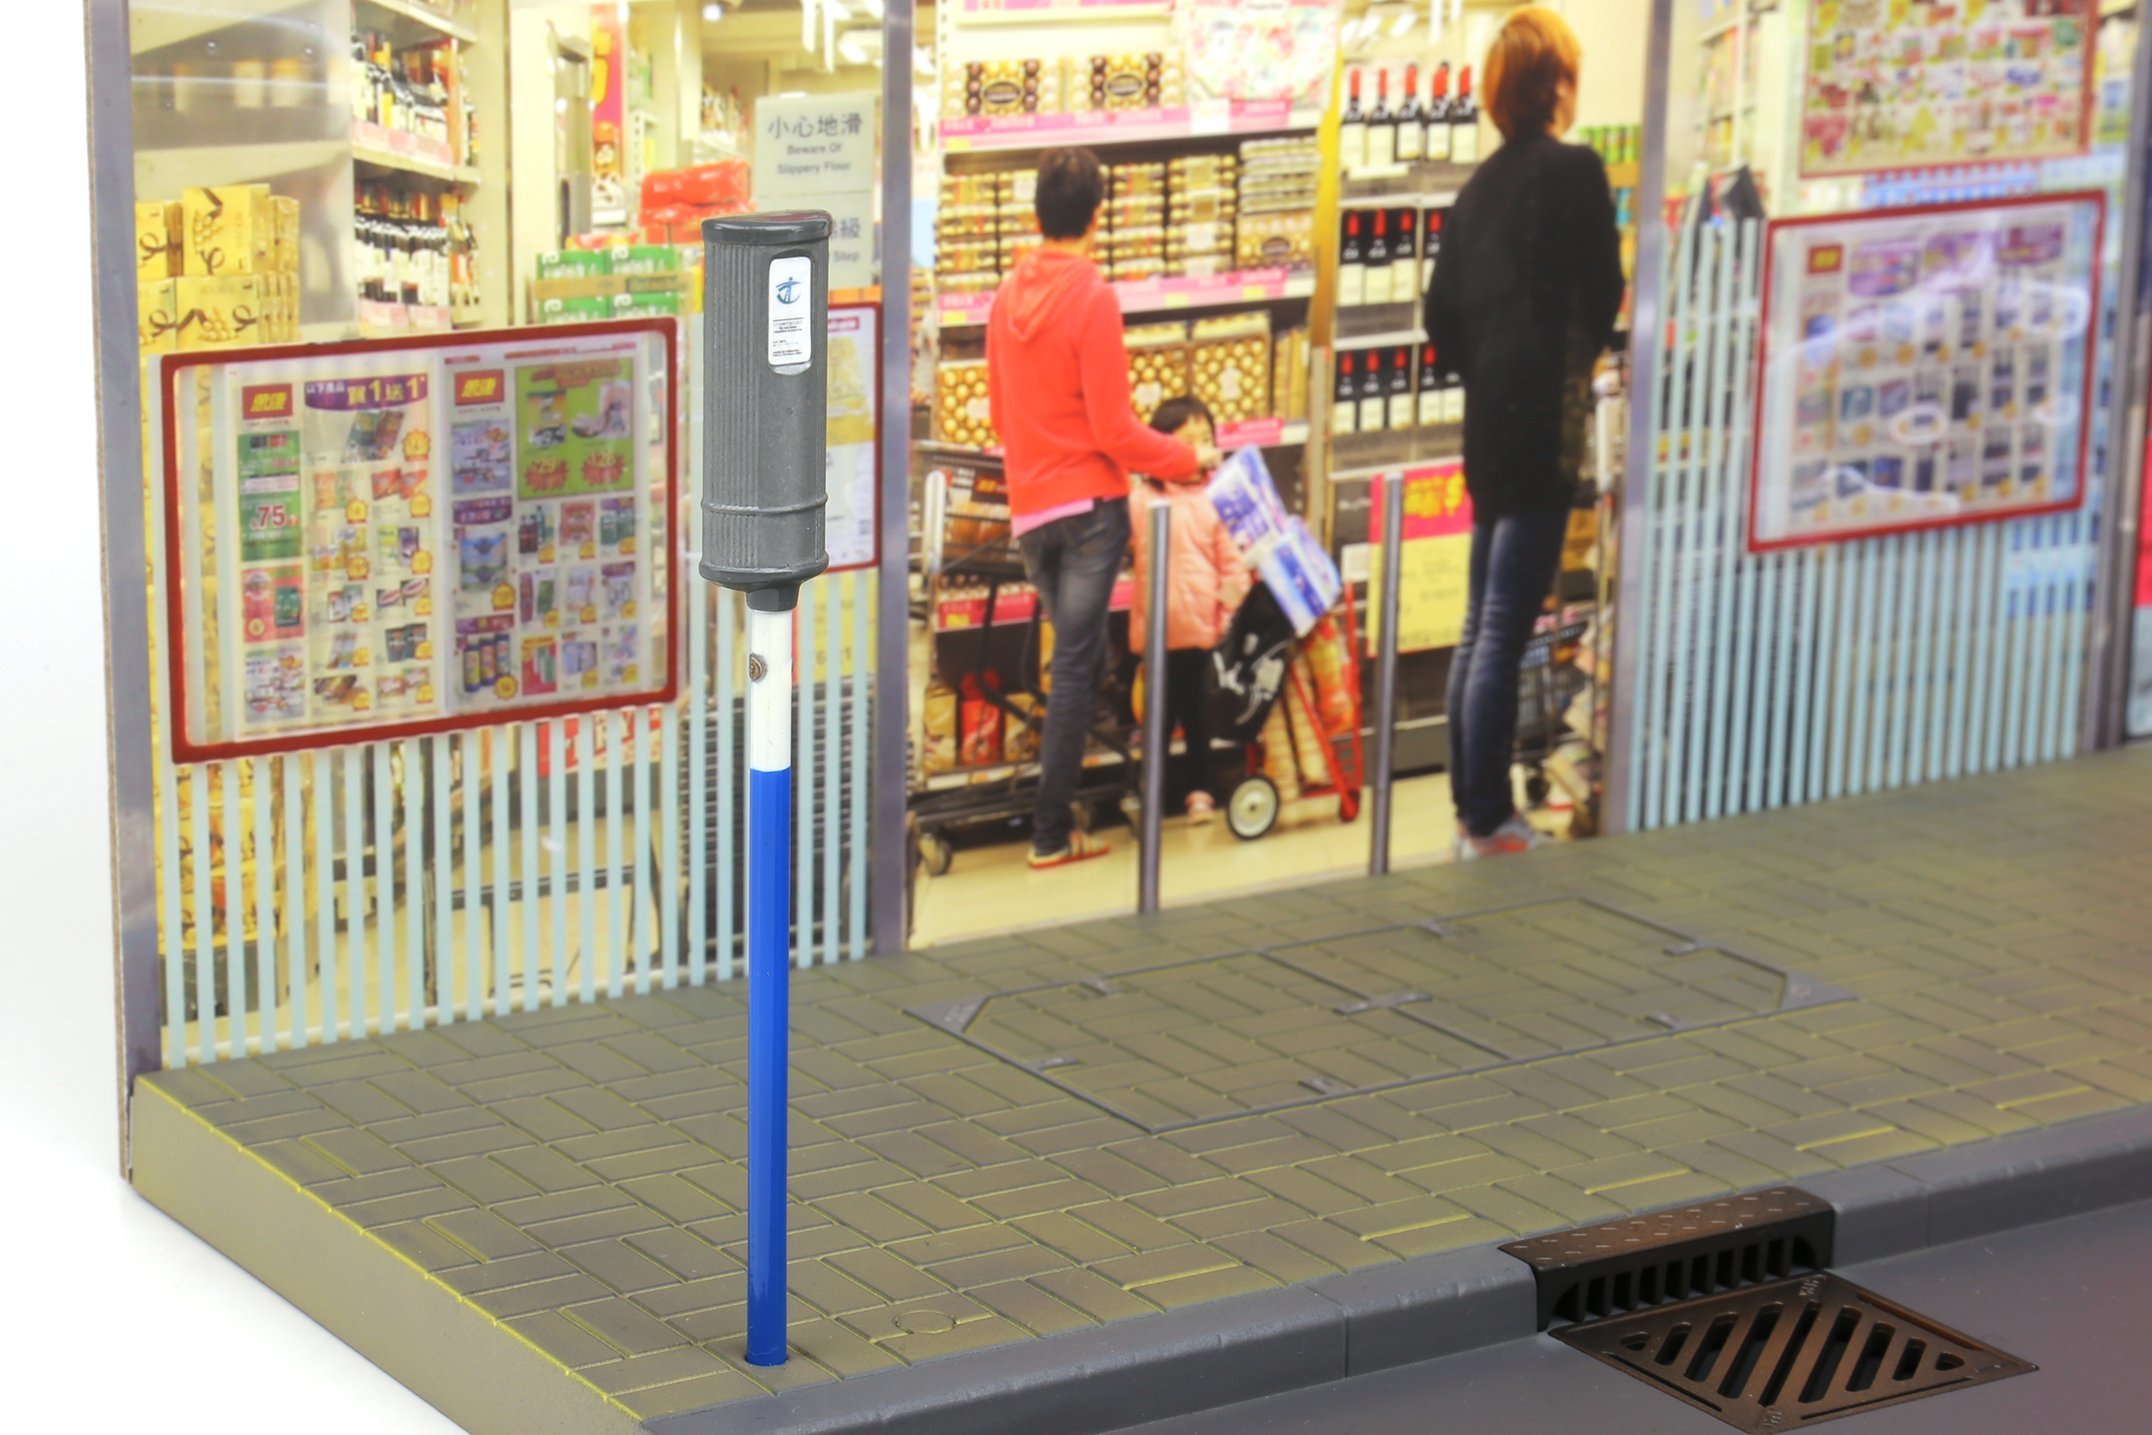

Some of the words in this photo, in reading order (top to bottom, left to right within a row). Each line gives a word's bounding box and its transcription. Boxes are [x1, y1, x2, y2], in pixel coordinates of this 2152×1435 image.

[768, 113, 862, 139] 小心地滑
[787, 144, 827, 155] Beware
[777, 163, 820, 175] Slippery
[824, 161, 851, 171] Floor
